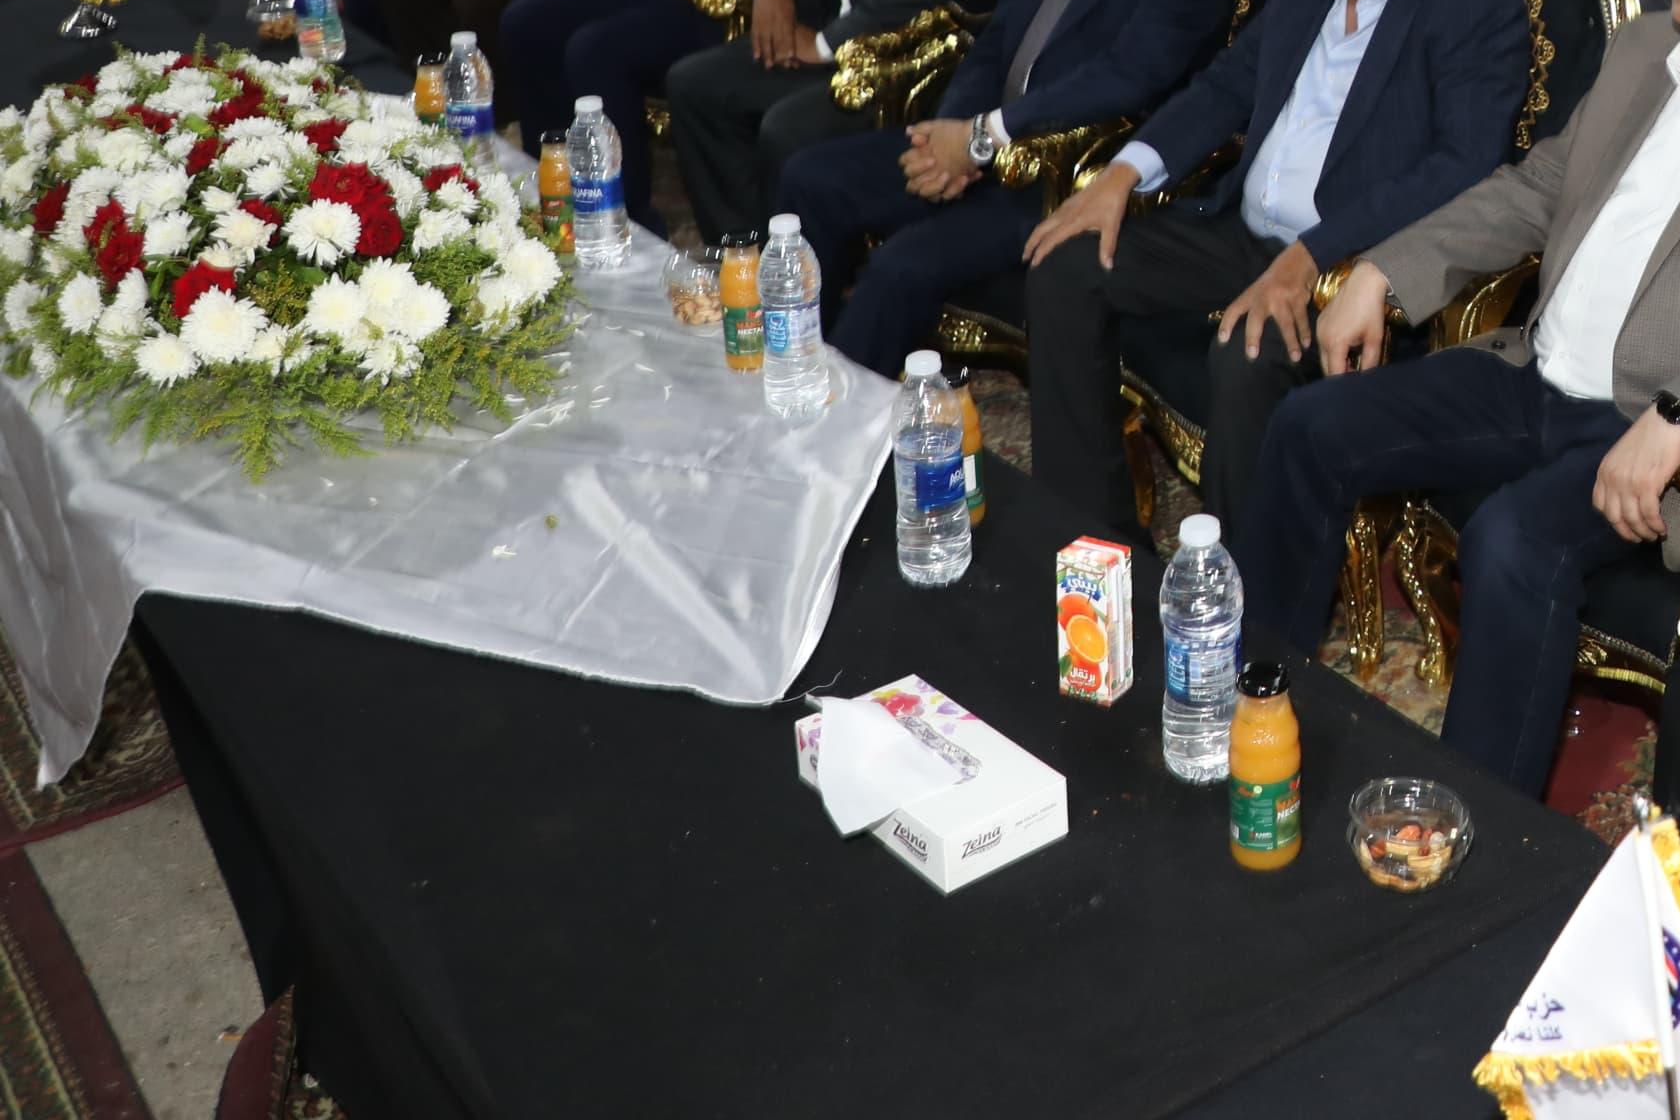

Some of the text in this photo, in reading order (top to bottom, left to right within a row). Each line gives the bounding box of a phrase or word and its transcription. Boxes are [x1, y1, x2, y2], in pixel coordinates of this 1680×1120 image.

[574, 187, 604, 200] UAFINA
[893, 818, 928, 853] Zeina
[961, 825, 1001, 859] Zeina
[1527, 992, 1565, 1020] حزب
